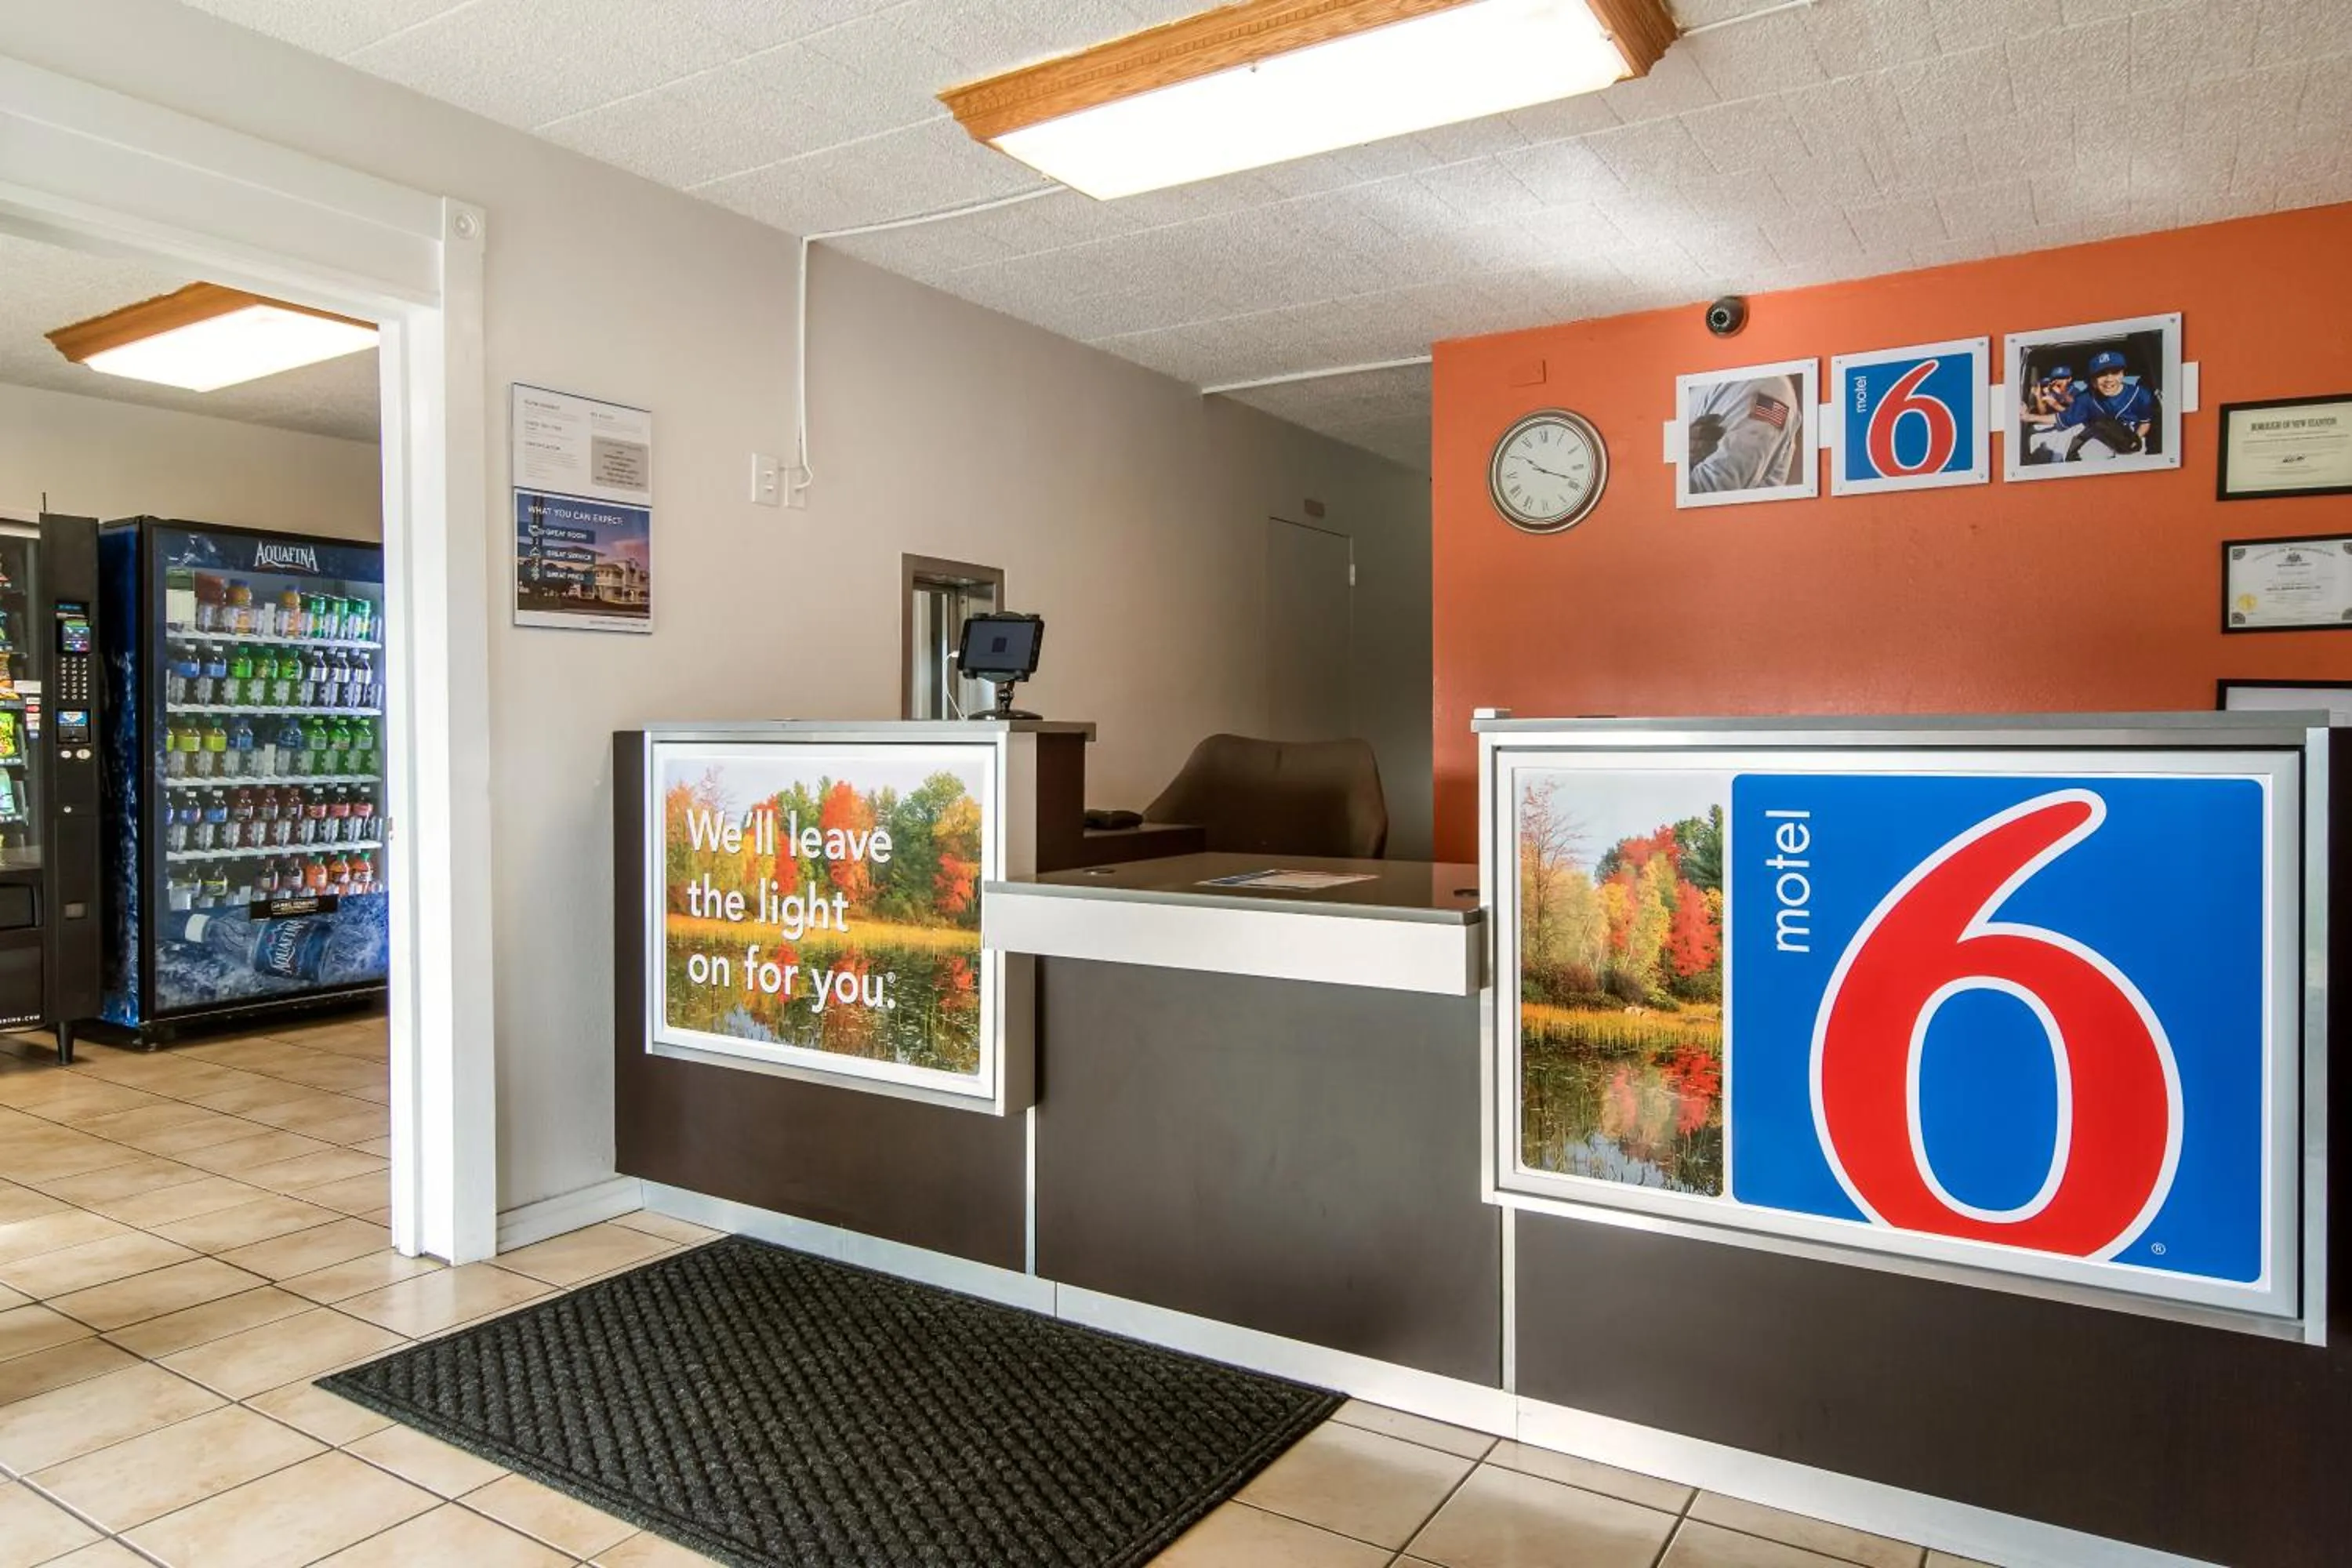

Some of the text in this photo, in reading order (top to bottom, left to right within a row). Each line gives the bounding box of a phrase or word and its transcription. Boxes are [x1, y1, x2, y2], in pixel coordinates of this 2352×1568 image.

[1854, 358, 1958, 478] motel 6
[527, 504, 552, 516] WHAT
[554, 508, 572, 519] YOU
[573, 510, 591, 521] CAN
[545, 528, 566, 537] GREAT
[253, 539, 320, 573] AQUAFINA
[789, 809, 893, 863] leave
[686, 873, 850, 941] the light
[687, 952, 731, 988] on
[743, 945, 799, 996] for
[1765, 788, 2185, 1264] motel 6
